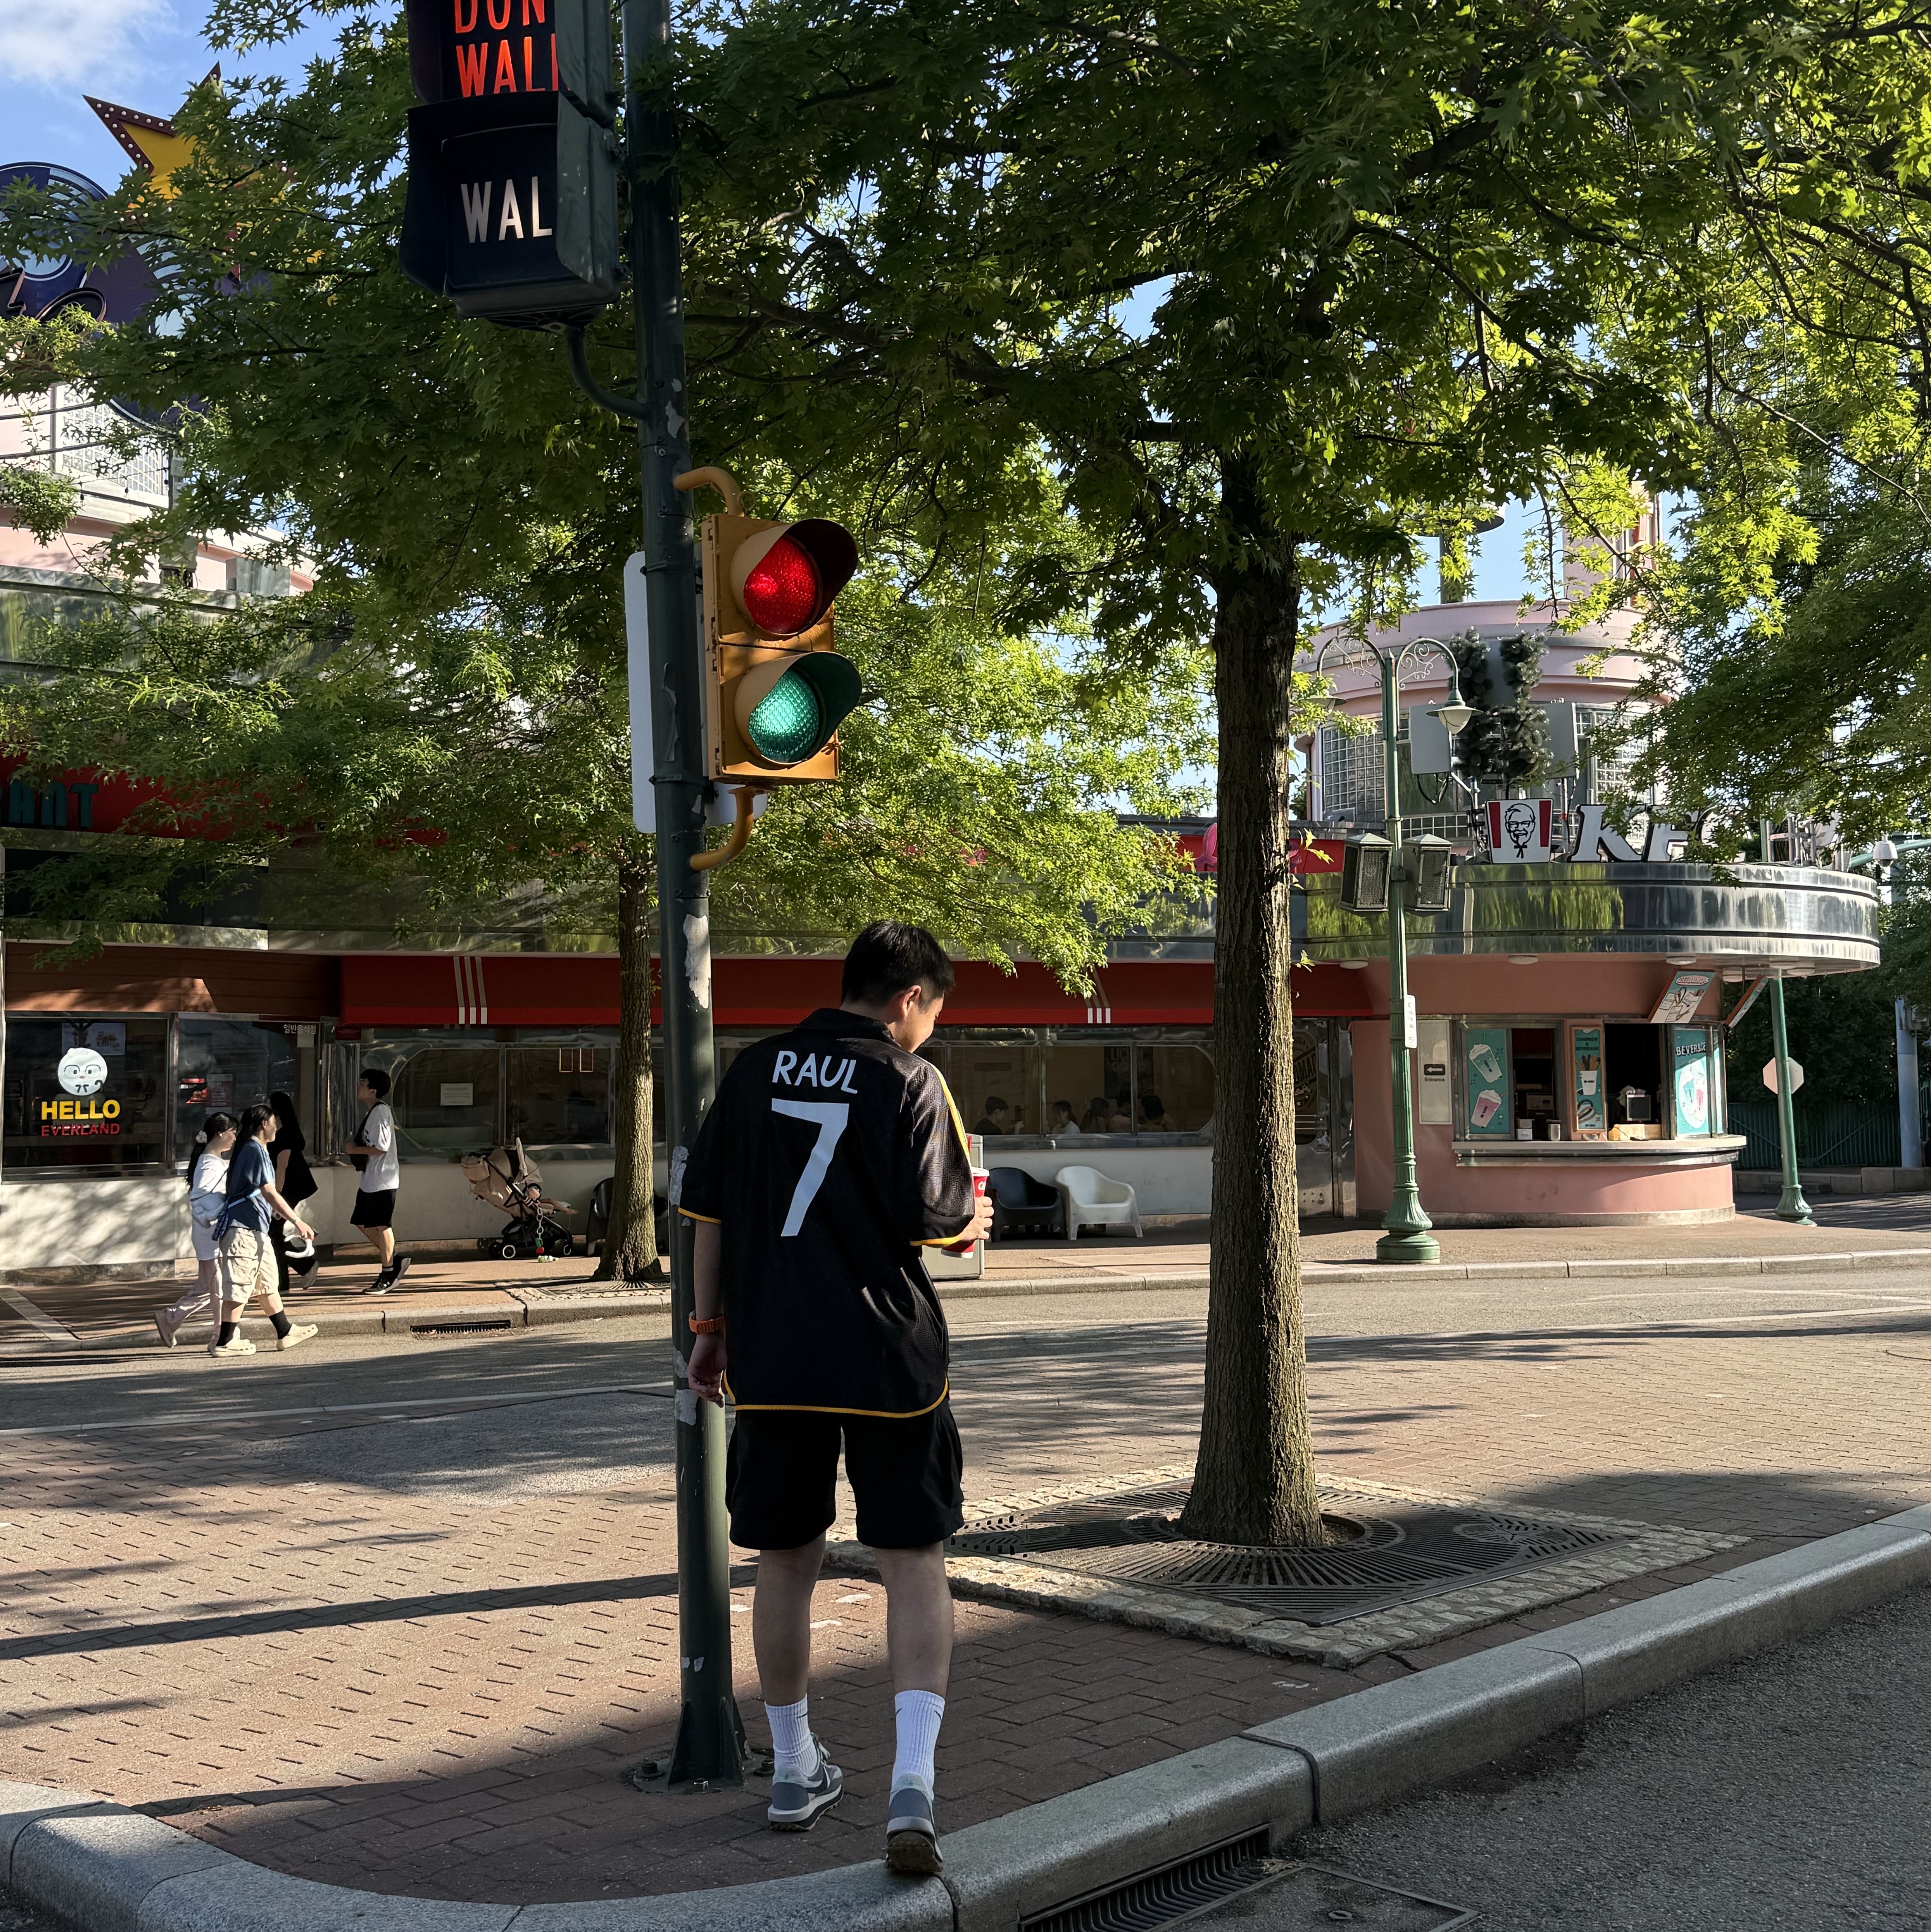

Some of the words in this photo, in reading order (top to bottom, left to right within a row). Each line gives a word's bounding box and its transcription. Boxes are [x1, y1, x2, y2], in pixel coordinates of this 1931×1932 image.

[284, 1024, 316, 1034] 일반음식점
[771, 1050, 858, 1094] RAUL
[41, 1100, 120, 1120] HELLO
[41, 1123, 120, 1137] EVERLAND
[771, 1098, 849, 1237] 7
